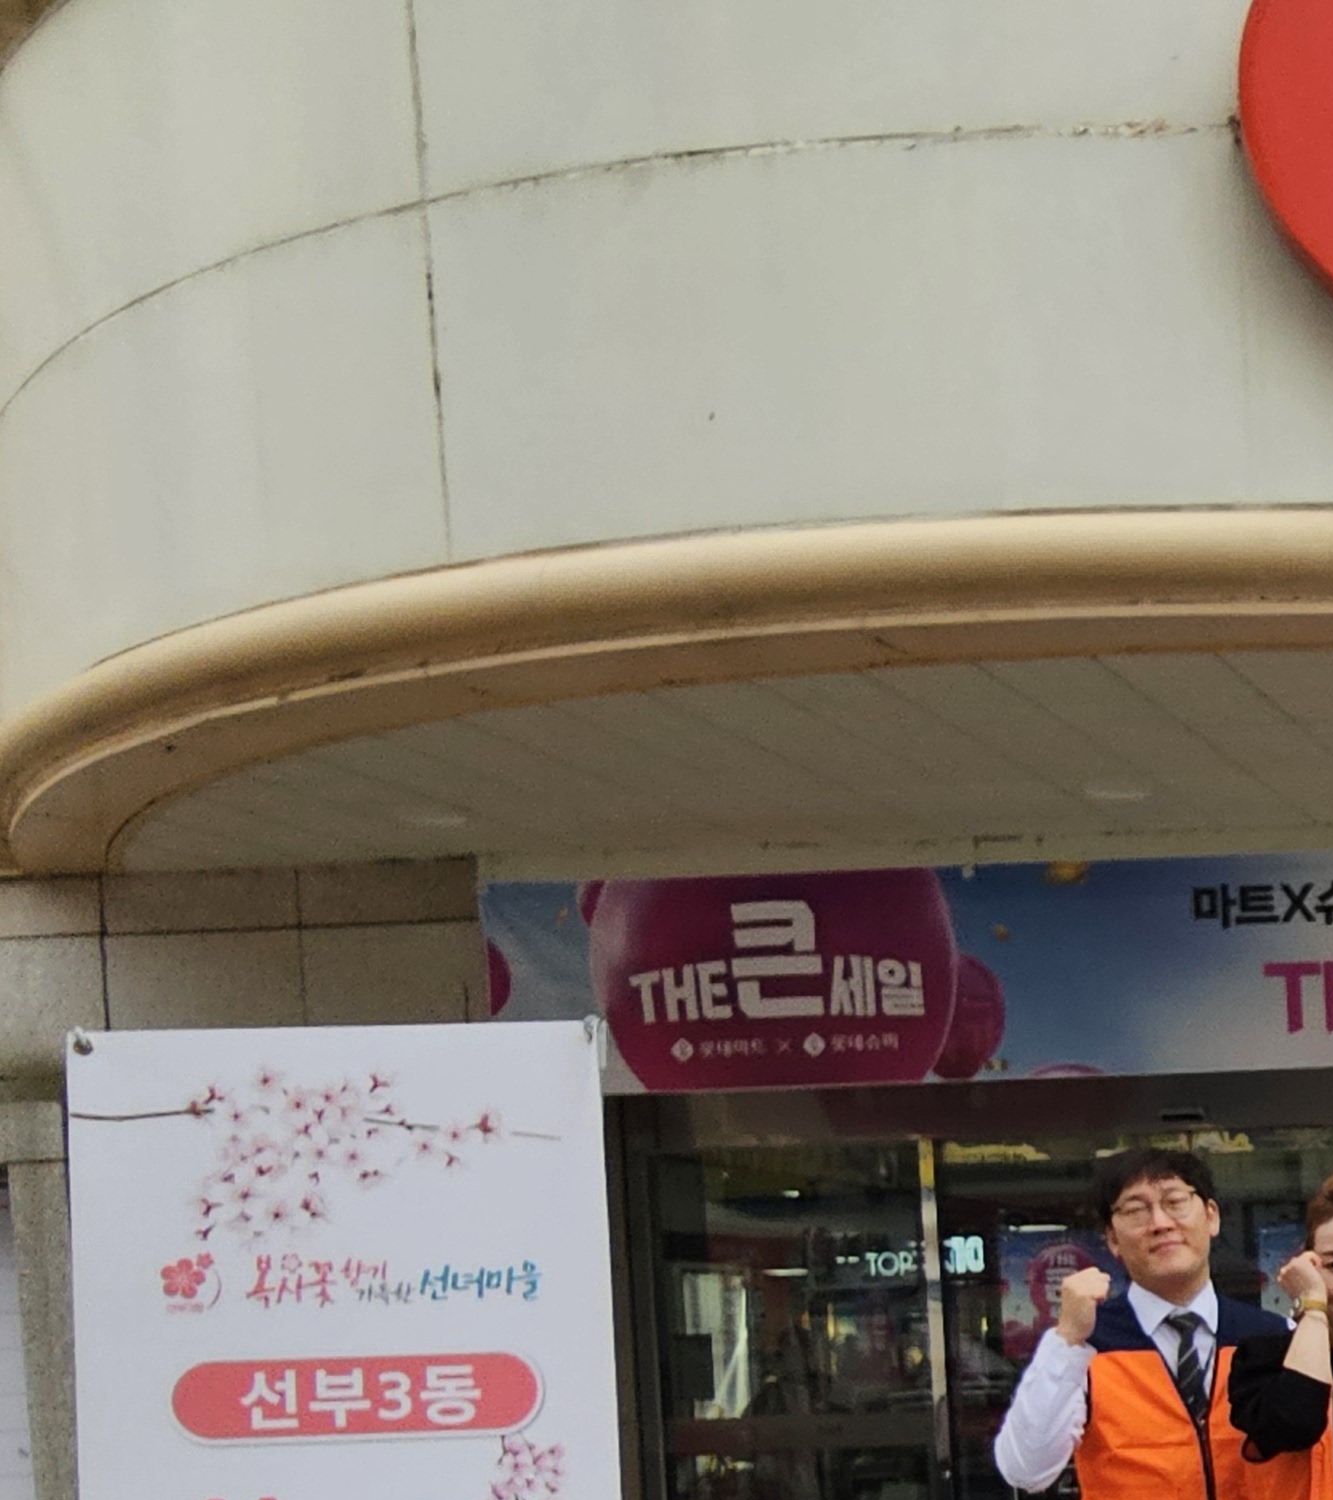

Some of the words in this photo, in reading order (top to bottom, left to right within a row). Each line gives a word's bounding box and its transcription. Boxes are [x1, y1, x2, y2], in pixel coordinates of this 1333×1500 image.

[246, 1253, 338, 1308] 복사꽃
[419, 1258, 545, 1301] 선녀마을
[240, 1364, 483, 1431] 선부3동
